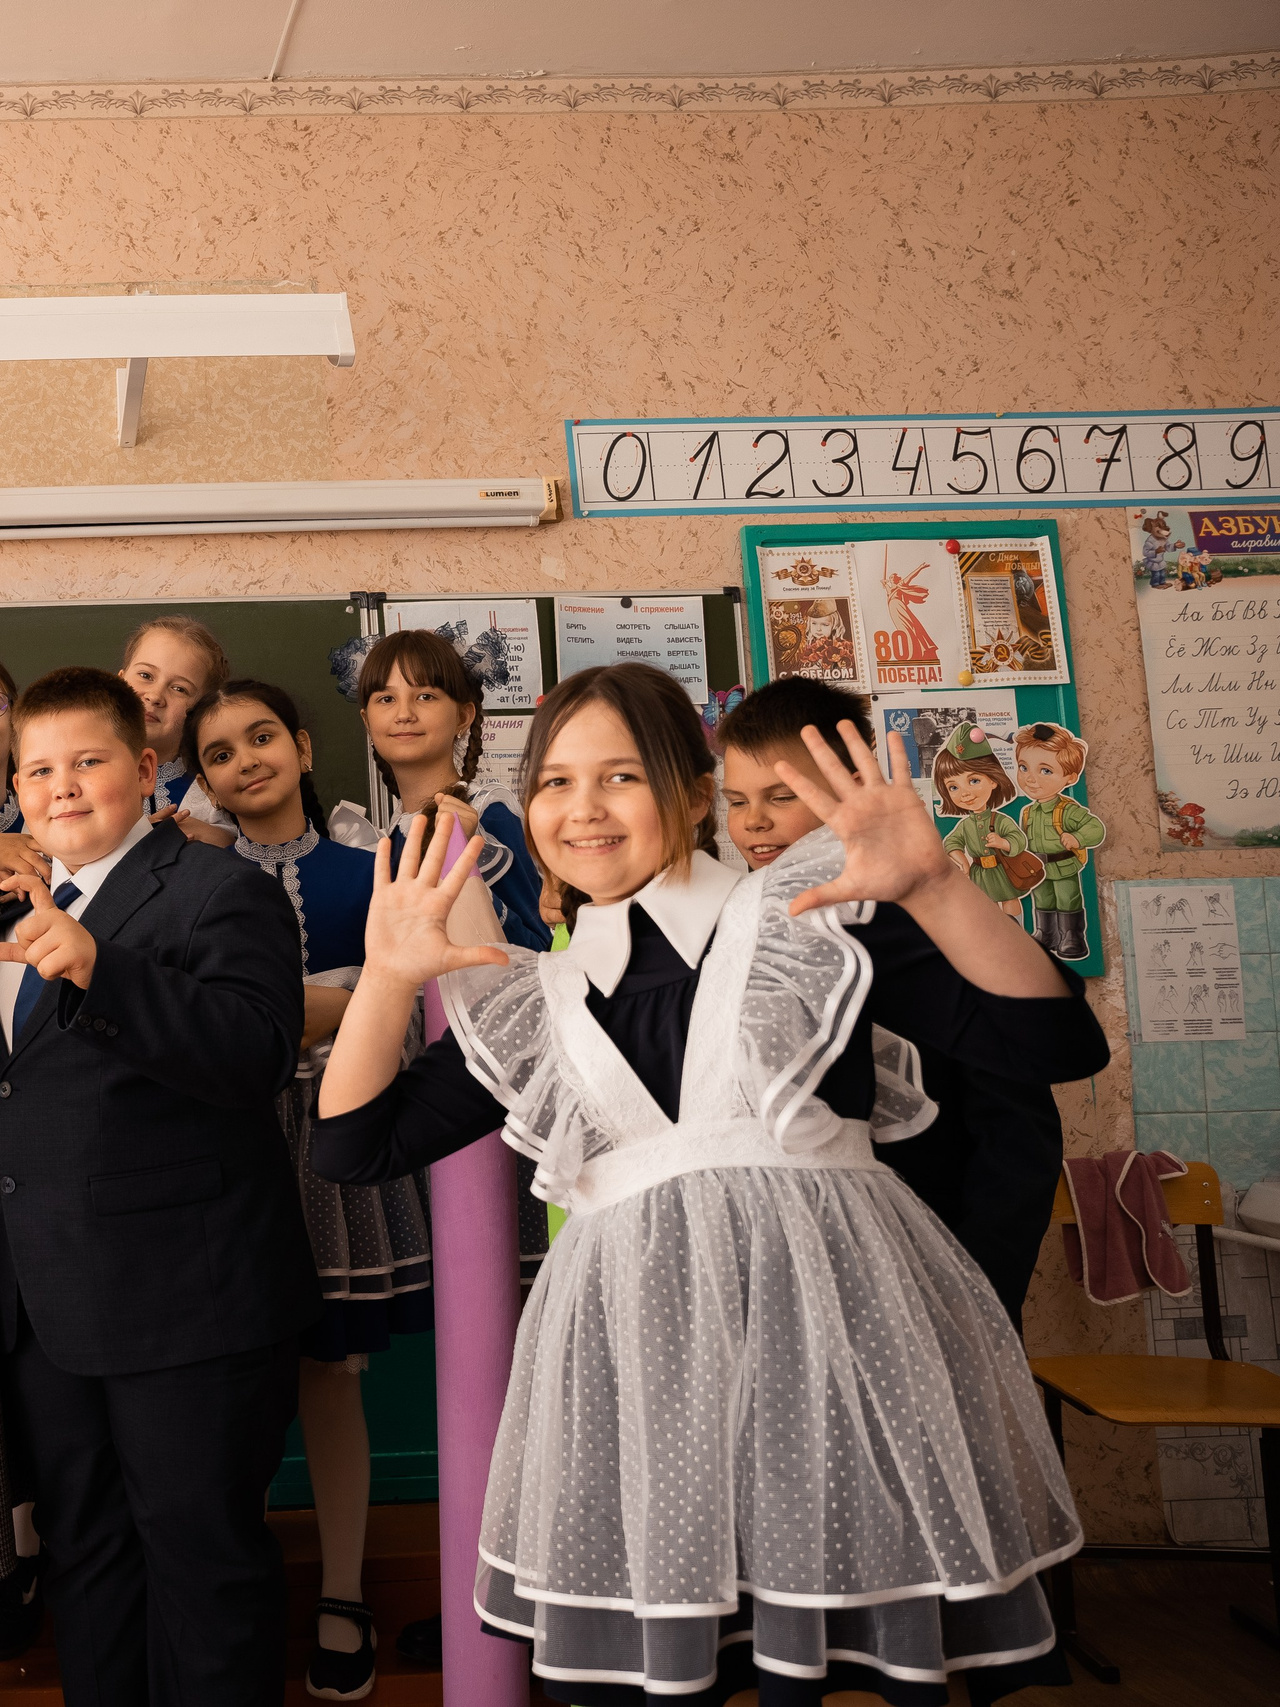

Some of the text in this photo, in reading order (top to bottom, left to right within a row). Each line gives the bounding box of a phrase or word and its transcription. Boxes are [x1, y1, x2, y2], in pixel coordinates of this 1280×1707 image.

[603, 421, 1264, 501] 0 1 2 3 4 5 6 7 8 9
[997, 553, 1018, 562] Днем
[565, 605, 604, 614] спряжение
[640, 606, 684, 614] спряжение
[1172, 600, 1268, 622] Аа Бб Вв
[874, 630, 909, 661] 80
[1165, 635, 1268, 663] Ёё Жж Зз
[877, 666, 942, 685] ПОБЕДА!
[1161, 670, 1276, 694] Лл Мм Нн
[512, 694, 531, 704] (-ят)
[1167, 707, 1268, 734] Сс Тт Уу
[1190, 743, 1262, 764] Чч Шш
[1226, 780, 1249, 799] Ээ
